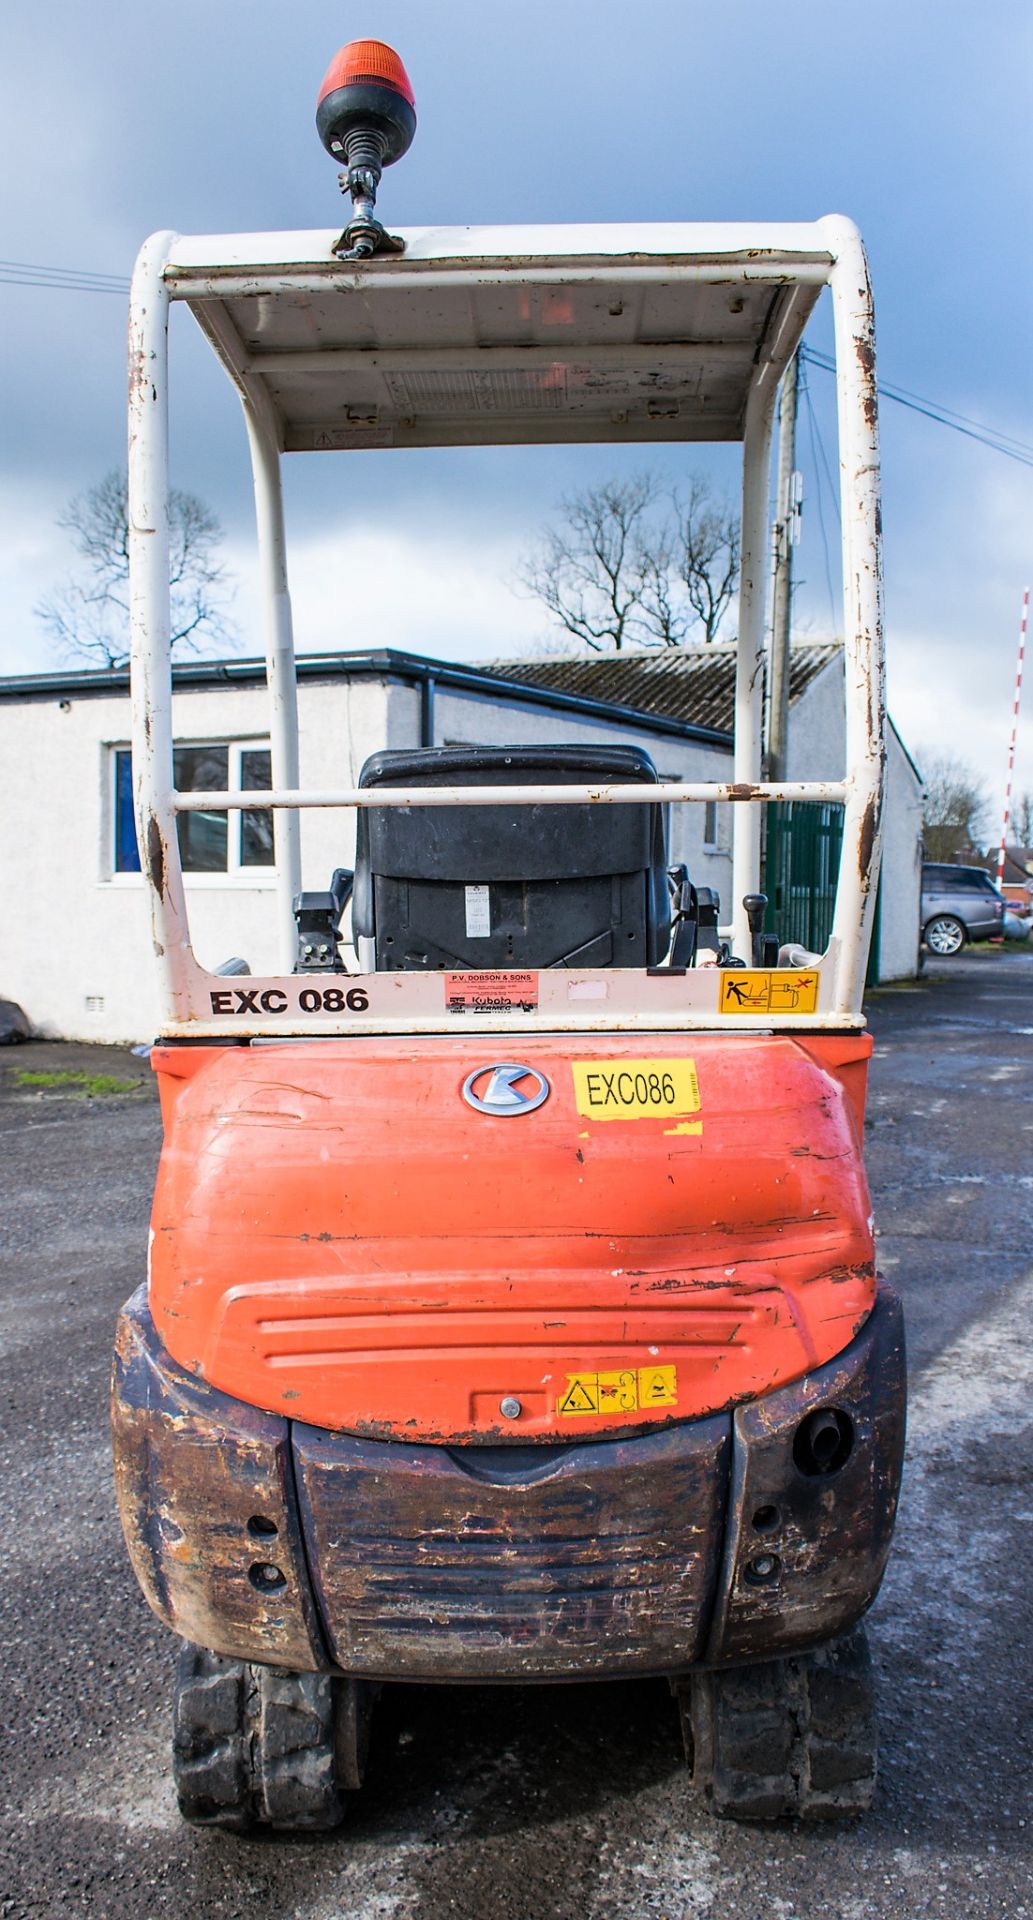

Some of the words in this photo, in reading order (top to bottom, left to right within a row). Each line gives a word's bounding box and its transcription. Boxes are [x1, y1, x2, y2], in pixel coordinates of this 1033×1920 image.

[210, 989, 288, 1015] EXC
[298, 987, 369, 1013] 086
[472, 996, 511, 1005] Kubota
[586, 1072, 675, 1106] EXC086
